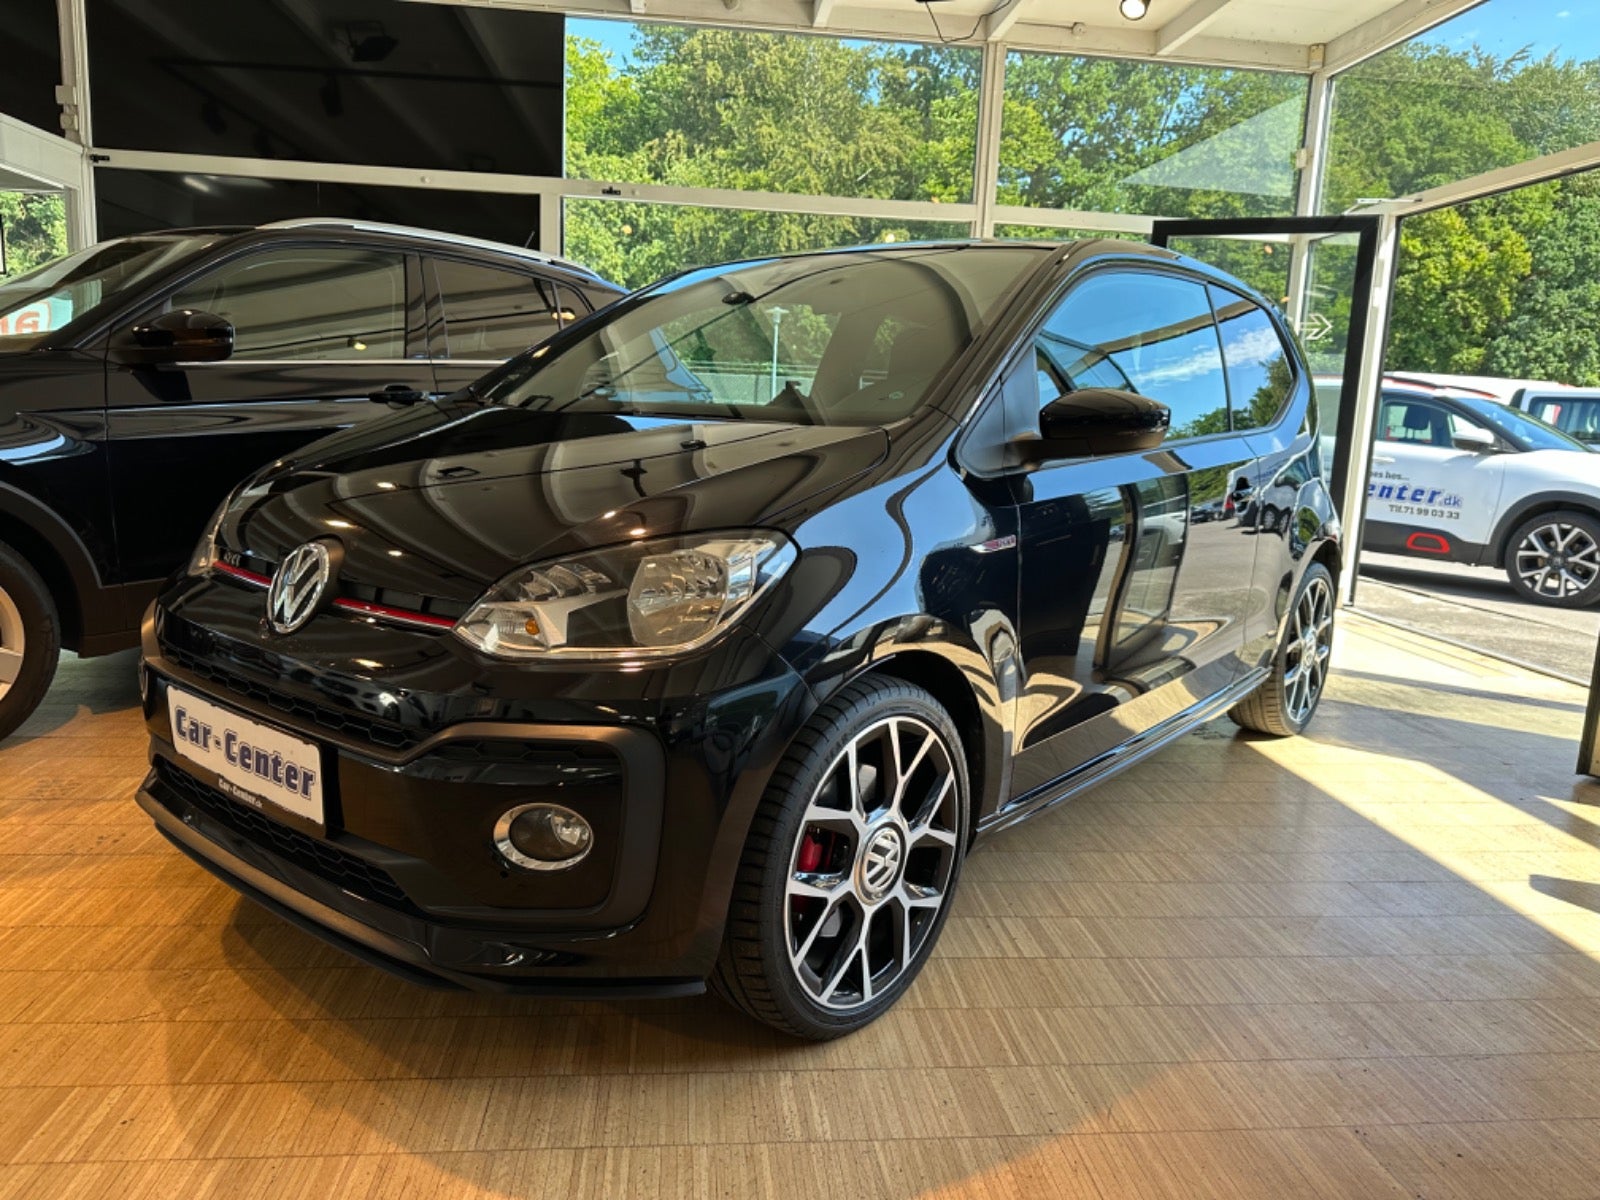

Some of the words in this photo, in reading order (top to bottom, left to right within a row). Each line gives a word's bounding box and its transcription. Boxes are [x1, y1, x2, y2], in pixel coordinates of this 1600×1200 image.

[1416, 506, 1430, 517] 99
[1431, 508, 1445, 518] 03
[1446, 510, 1460, 520] 33
